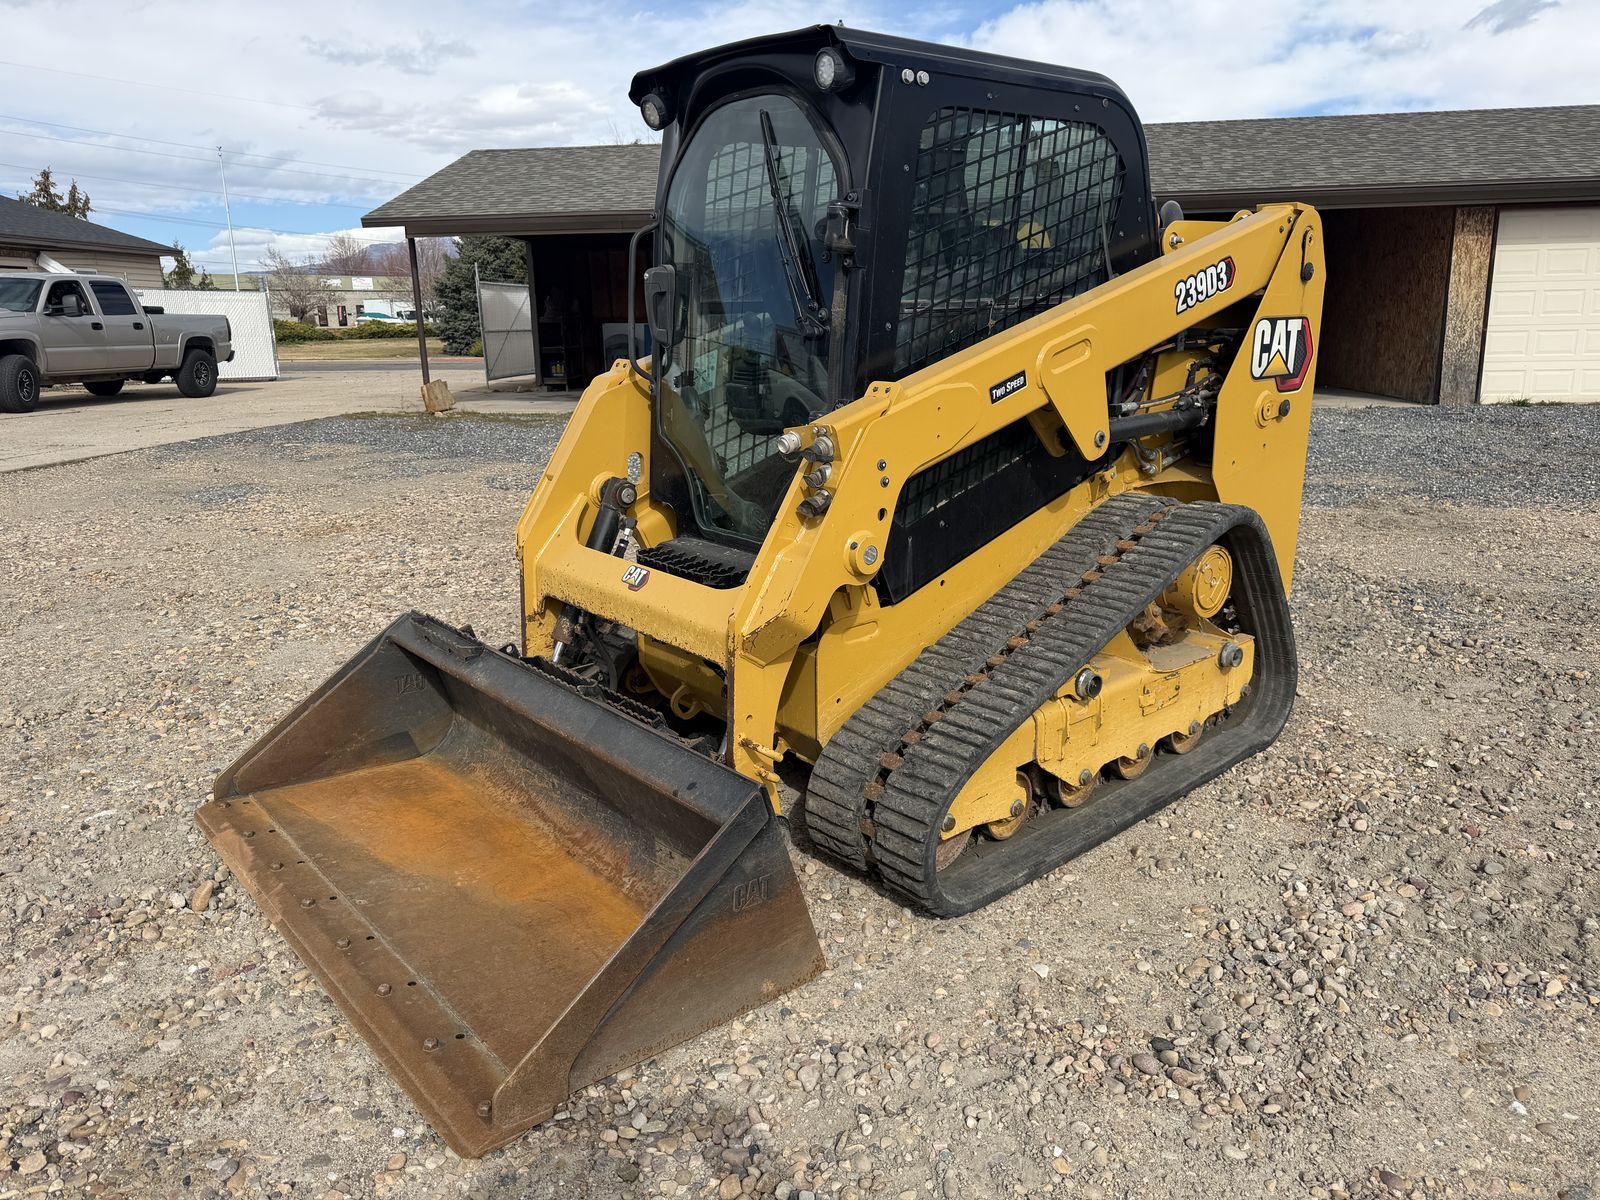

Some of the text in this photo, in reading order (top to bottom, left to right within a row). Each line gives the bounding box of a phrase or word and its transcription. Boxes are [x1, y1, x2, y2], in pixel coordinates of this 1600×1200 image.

[1175, 260, 1227, 313] 239D3
[1252, 318, 1303, 378] CAT
[1006, 376, 1025, 392] SPEED
[622, 564, 648, 586] CAT
[732, 872, 773, 913] CAT
